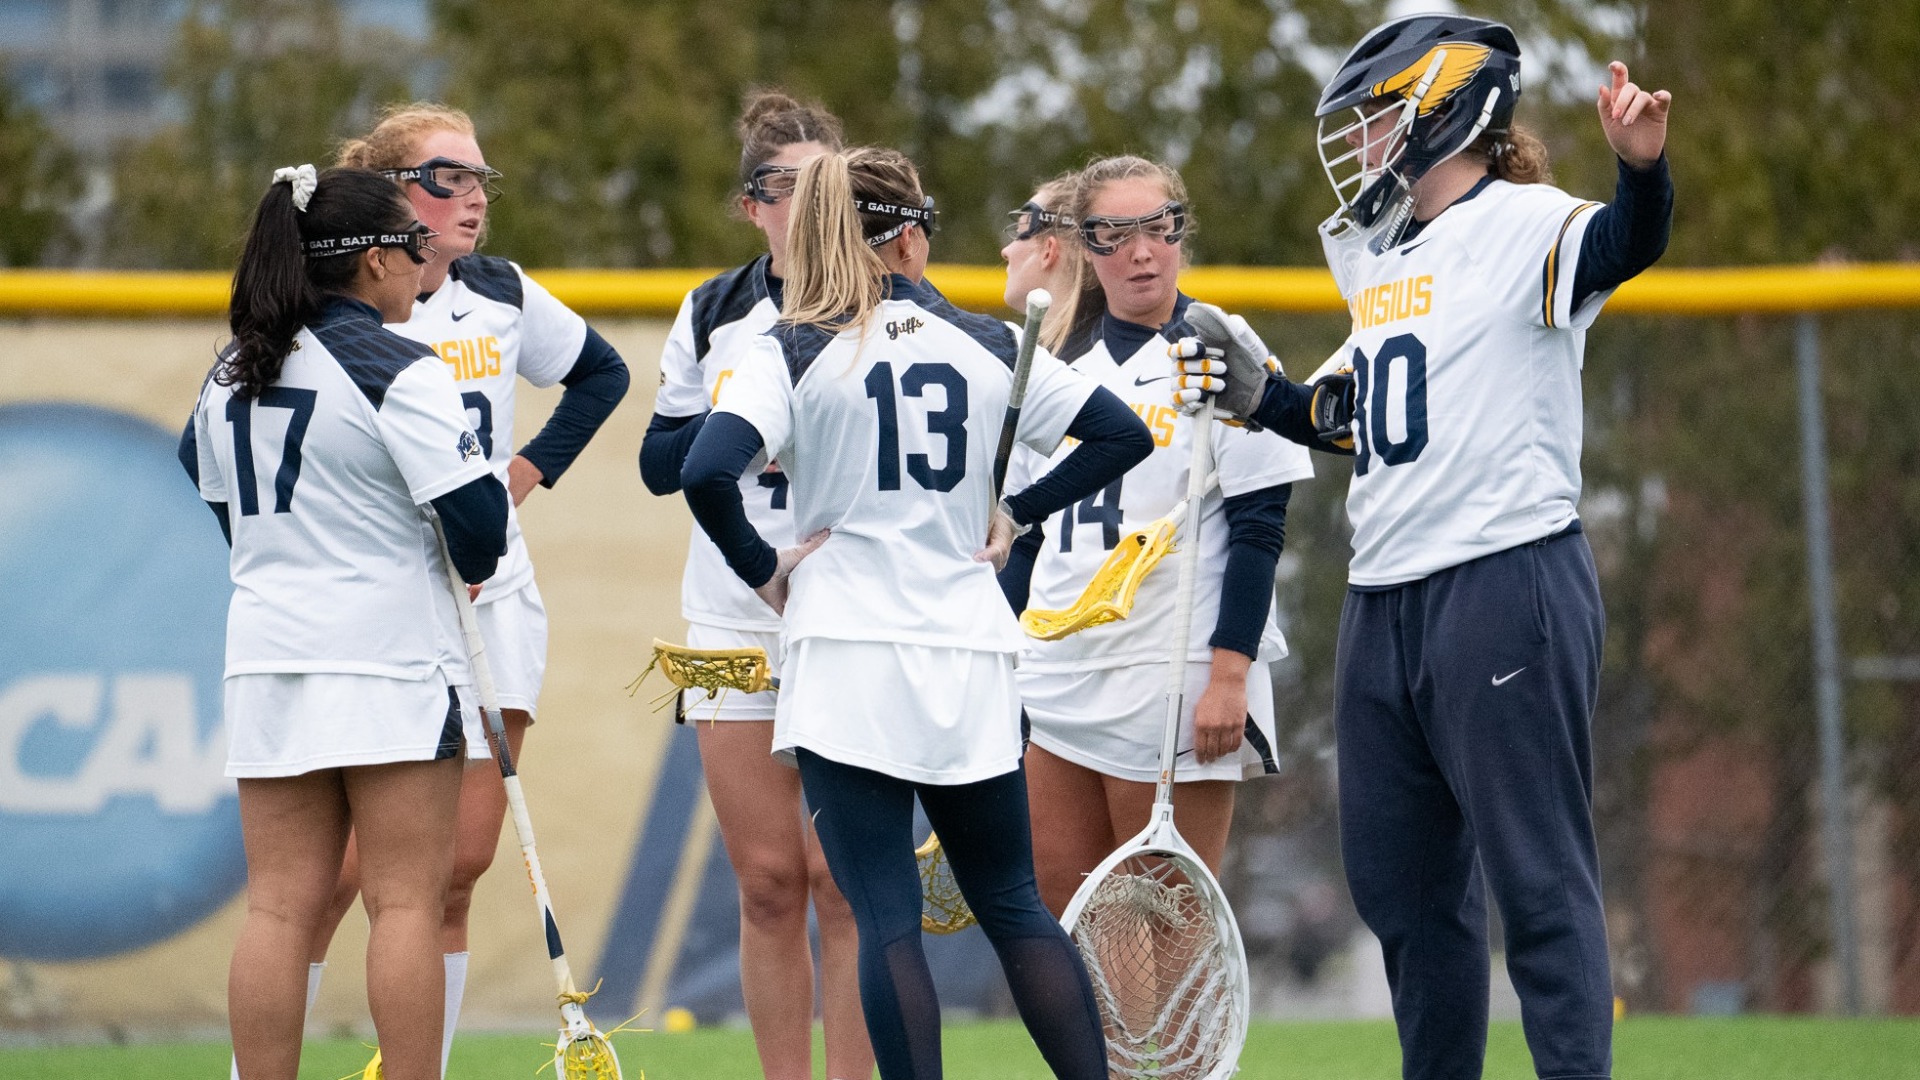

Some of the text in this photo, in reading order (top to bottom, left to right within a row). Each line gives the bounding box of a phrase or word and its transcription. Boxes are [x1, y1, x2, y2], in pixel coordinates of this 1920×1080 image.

[868, 202, 898, 214] GAIT
[900, 207, 922, 219] GAIT
[1380, 195, 1415, 252] WARRIOR
[309, 239, 335, 250] GAIT
[341, 235, 375, 246] GAIT
[380, 234, 410, 244] GAIT
[1353, 274, 1433, 333] NISIUS
[431, 336, 501, 381] SIUS
[226, 386, 318, 516] 17
[864, 361, 968, 493] 13
